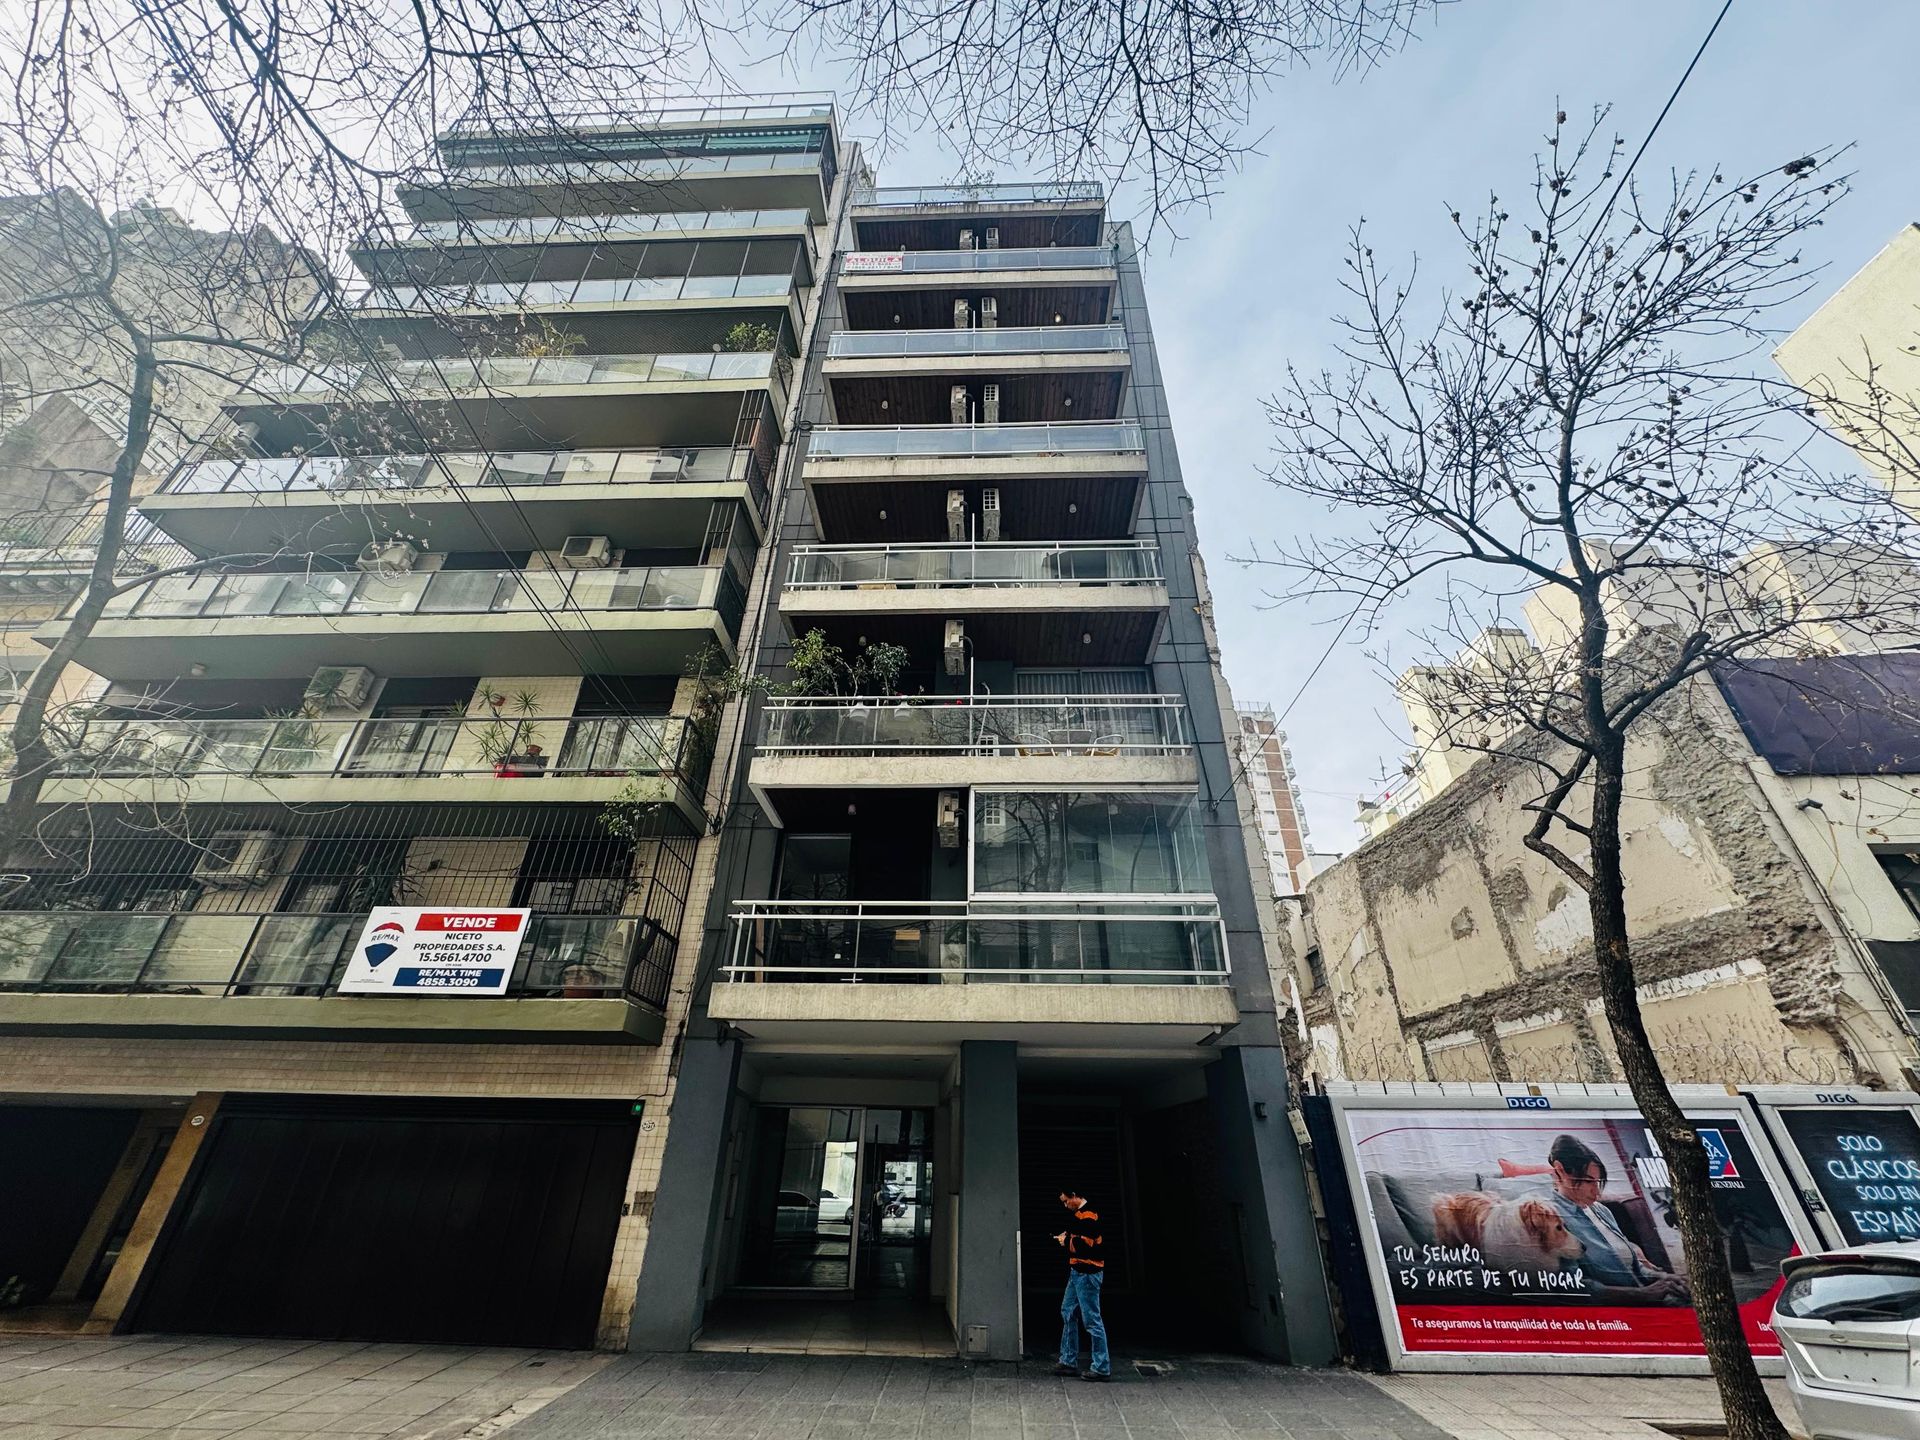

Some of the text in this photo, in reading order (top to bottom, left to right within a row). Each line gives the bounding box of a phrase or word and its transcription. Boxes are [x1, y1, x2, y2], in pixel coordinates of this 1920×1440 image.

[443, 917, 498, 929] VENDE
[371, 933, 400, 942] RE/MAX
[413, 943, 485, 951] PROPIEDADES
[419, 953, 492, 962] 15.5661.4700
[418, 969, 457, 977] RE/MAX
[416, 978, 479, 987] 4858.3090
[1837, 1136, 1882, 1151] SOLO
[1828, 1156, 1920, 1179] CLÁSICOS
[1856, 1186, 1920, 1200] SOLO EN
[1394, 1243, 1485, 1265] TU SEGURO,
[1400, 1268, 1586, 1290] ES PARTE DE TU HOGAR
[1411, 1318, 1632, 1331] Te aseguramos la tranquilidad de toda la familia.
